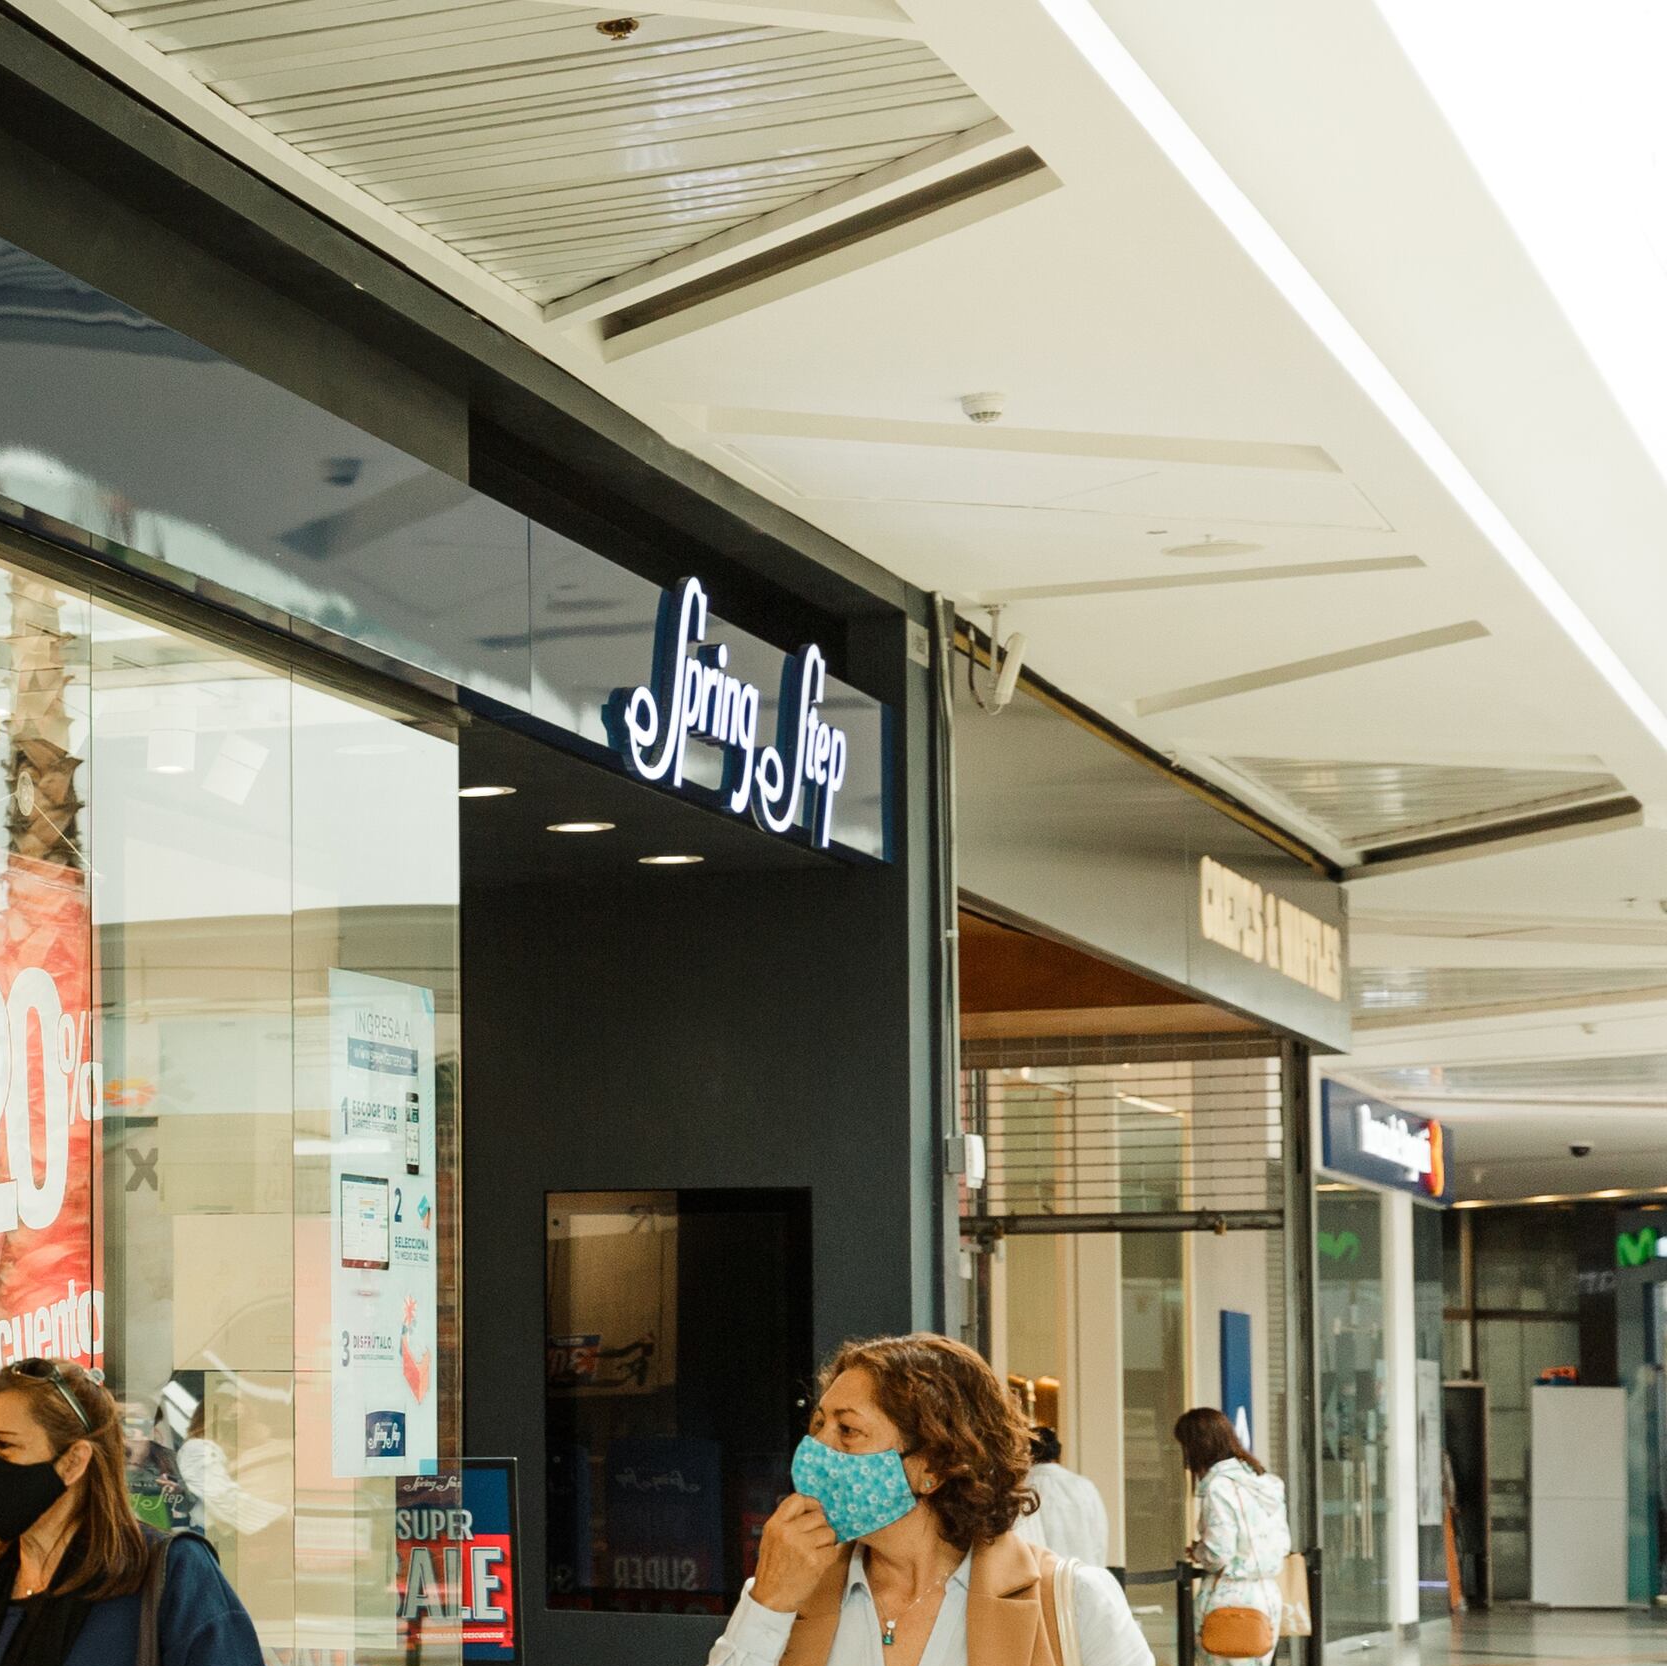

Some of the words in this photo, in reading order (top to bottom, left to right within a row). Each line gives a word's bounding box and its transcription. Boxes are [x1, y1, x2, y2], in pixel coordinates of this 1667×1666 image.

[624, 576, 761, 814] Spring
[754, 643, 848, 849] Step
[354, 1010, 401, 1040] INGRESA
[352, 1100, 381, 1119] ESCOGE
[383, 1104, 397, 1121] TUS
[394, 1187, 402, 1223] 2
[397, 1508, 474, 1541] SUPER
[397, 1547, 506, 1622] ALE
